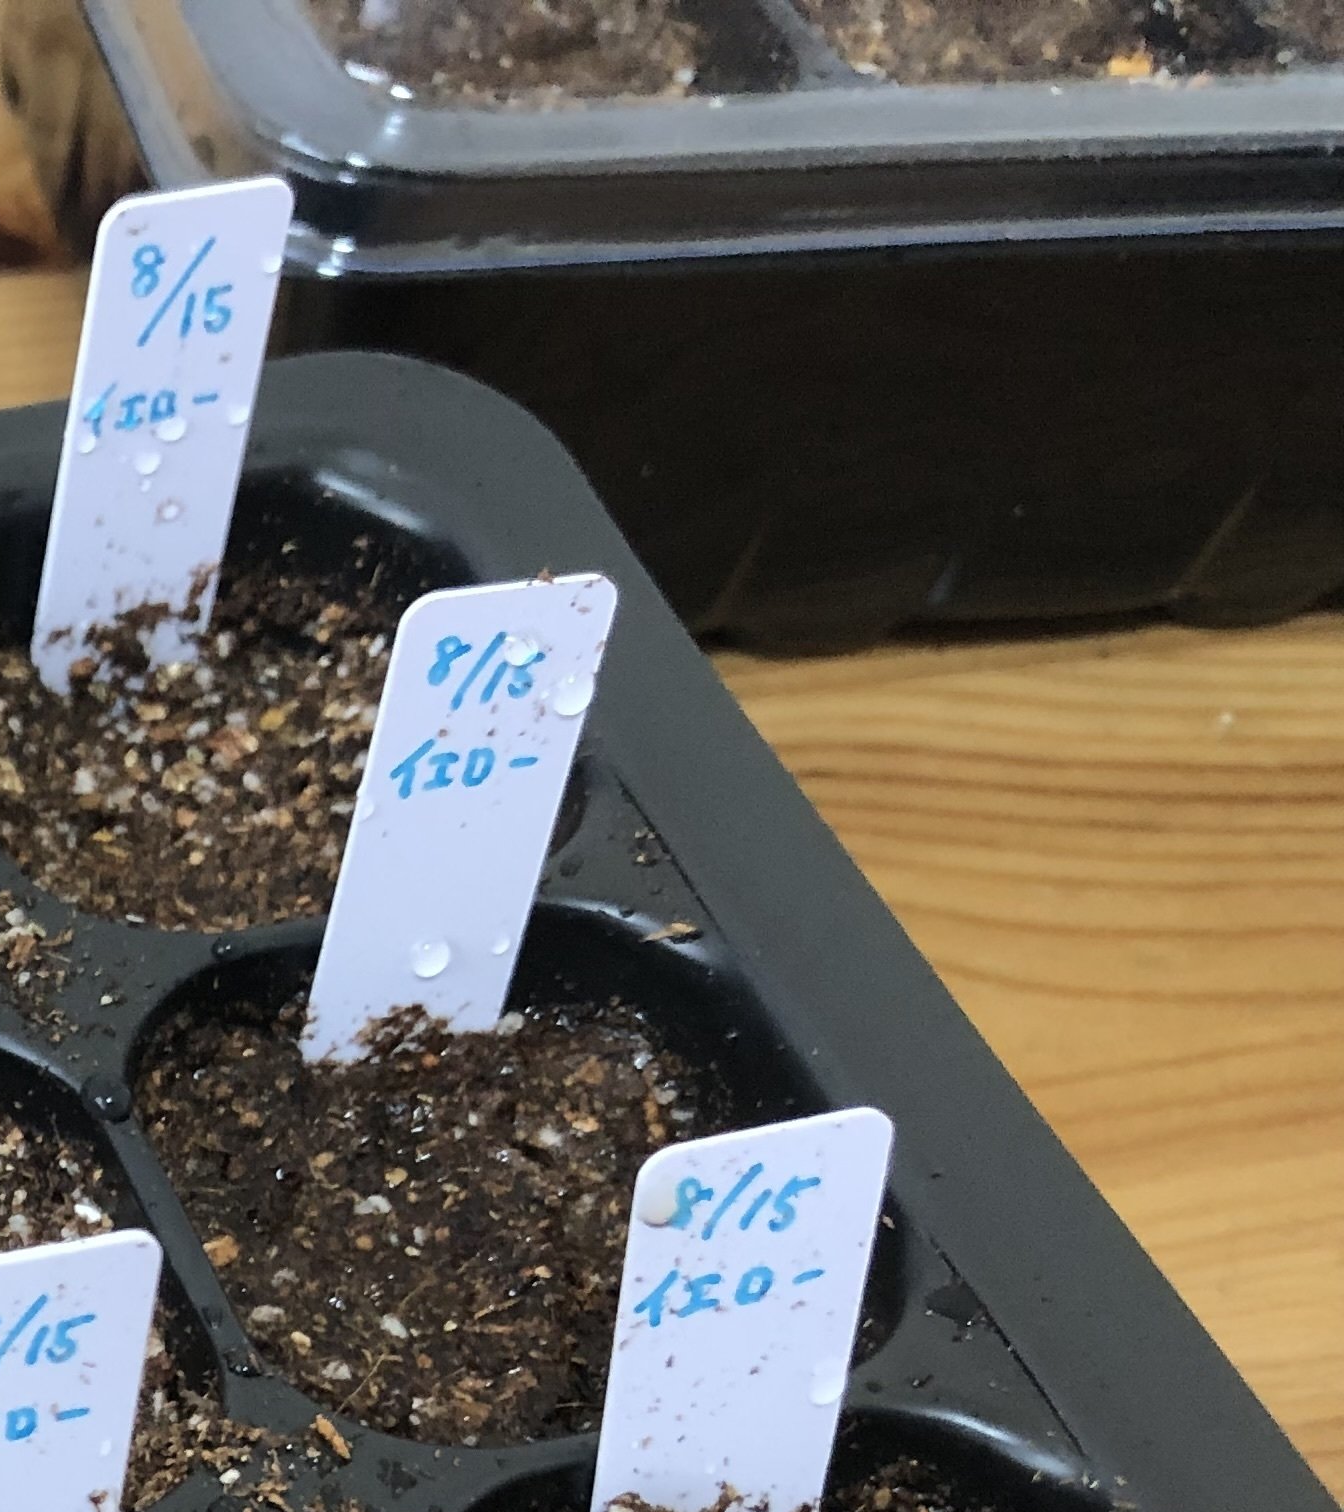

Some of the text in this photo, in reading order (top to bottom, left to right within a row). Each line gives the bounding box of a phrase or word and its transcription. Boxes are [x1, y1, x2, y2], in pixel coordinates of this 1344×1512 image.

[131, 236, 233, 347] 8/15
[426, 631, 546, 711] 8/15
[665, 1162, 822, 1241] 8/15
